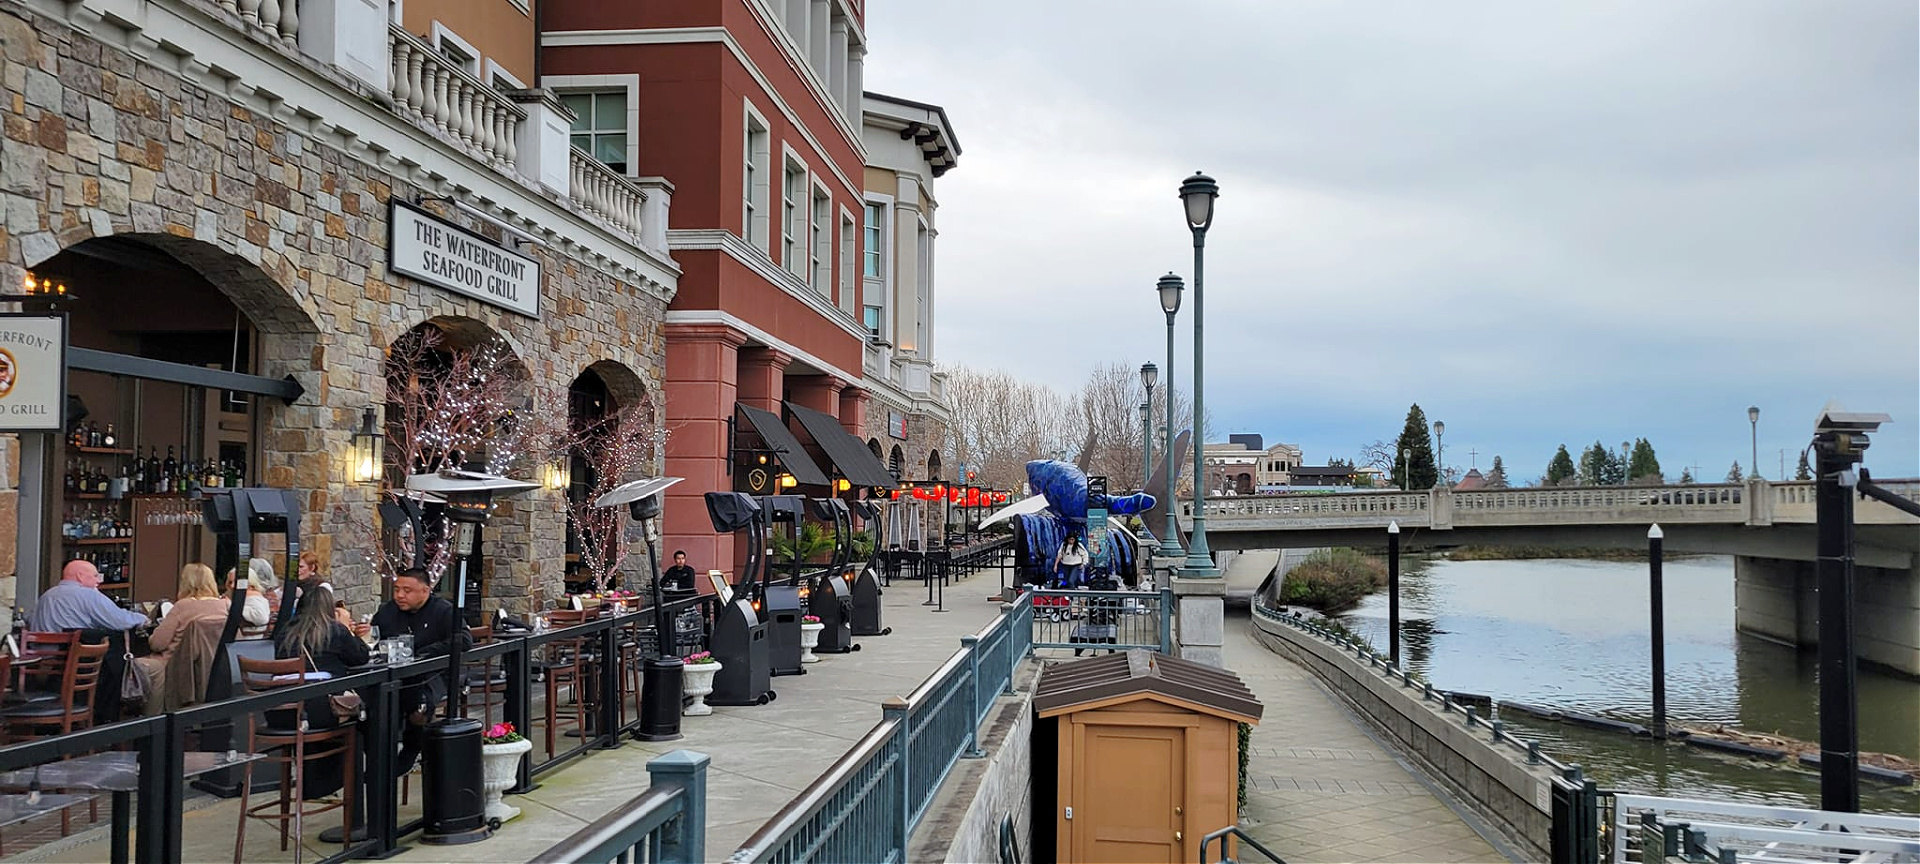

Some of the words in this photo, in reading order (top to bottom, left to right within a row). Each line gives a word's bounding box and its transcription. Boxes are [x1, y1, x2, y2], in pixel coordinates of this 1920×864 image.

[414, 219, 441, 248] THE
[446, 232, 525, 281] WATERFRONT
[423, 250, 482, 288] SEAFOOD
[487, 275, 518, 301] GRILL
[11, 404, 47, 415] GRILL
